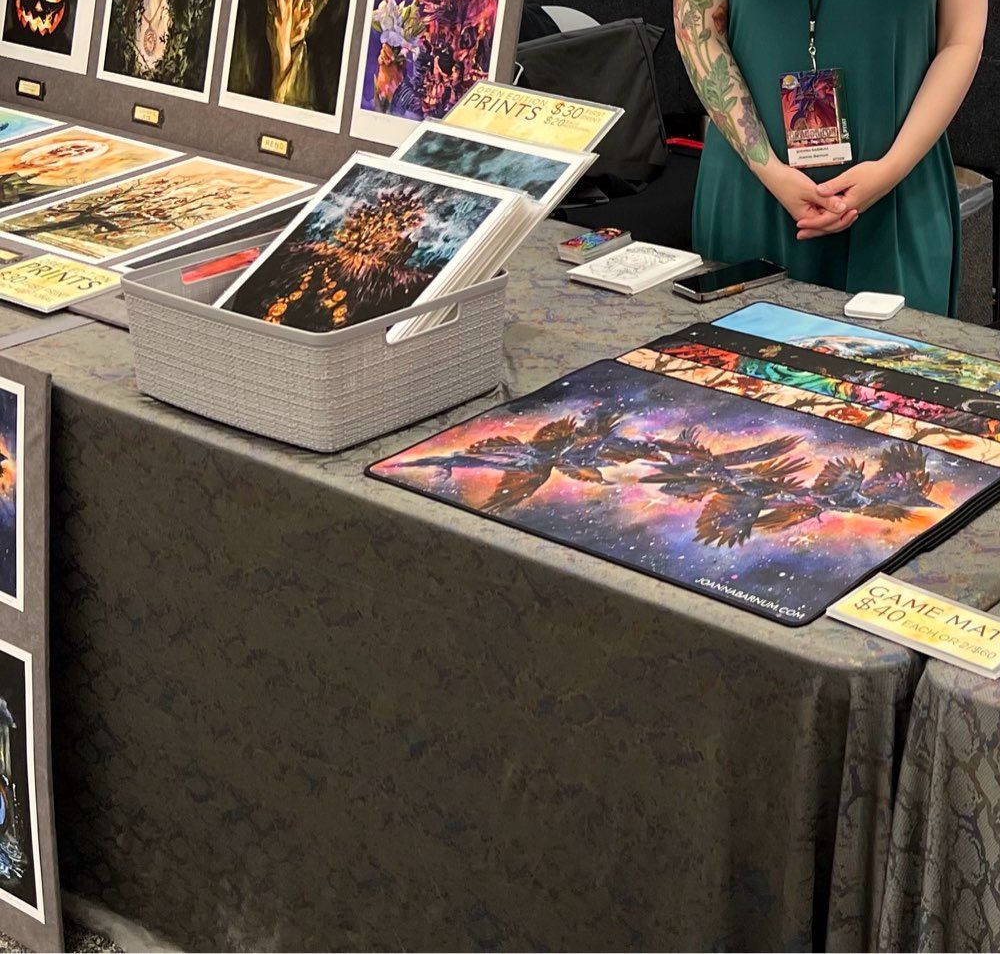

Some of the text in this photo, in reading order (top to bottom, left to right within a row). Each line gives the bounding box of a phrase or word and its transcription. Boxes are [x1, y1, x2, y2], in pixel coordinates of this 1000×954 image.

[463, 93, 542, 121] PRINTS
[550, 102, 584, 120] $30
[17, 262, 102, 291] PRINTS
[694, 576, 805, 620] JOANNABARNUM.COM
[868, 586, 944, 620] GAME
[854, 597, 906, 623] $40
[901, 619, 937, 638] EACH
[938, 634, 962, 646] OR
